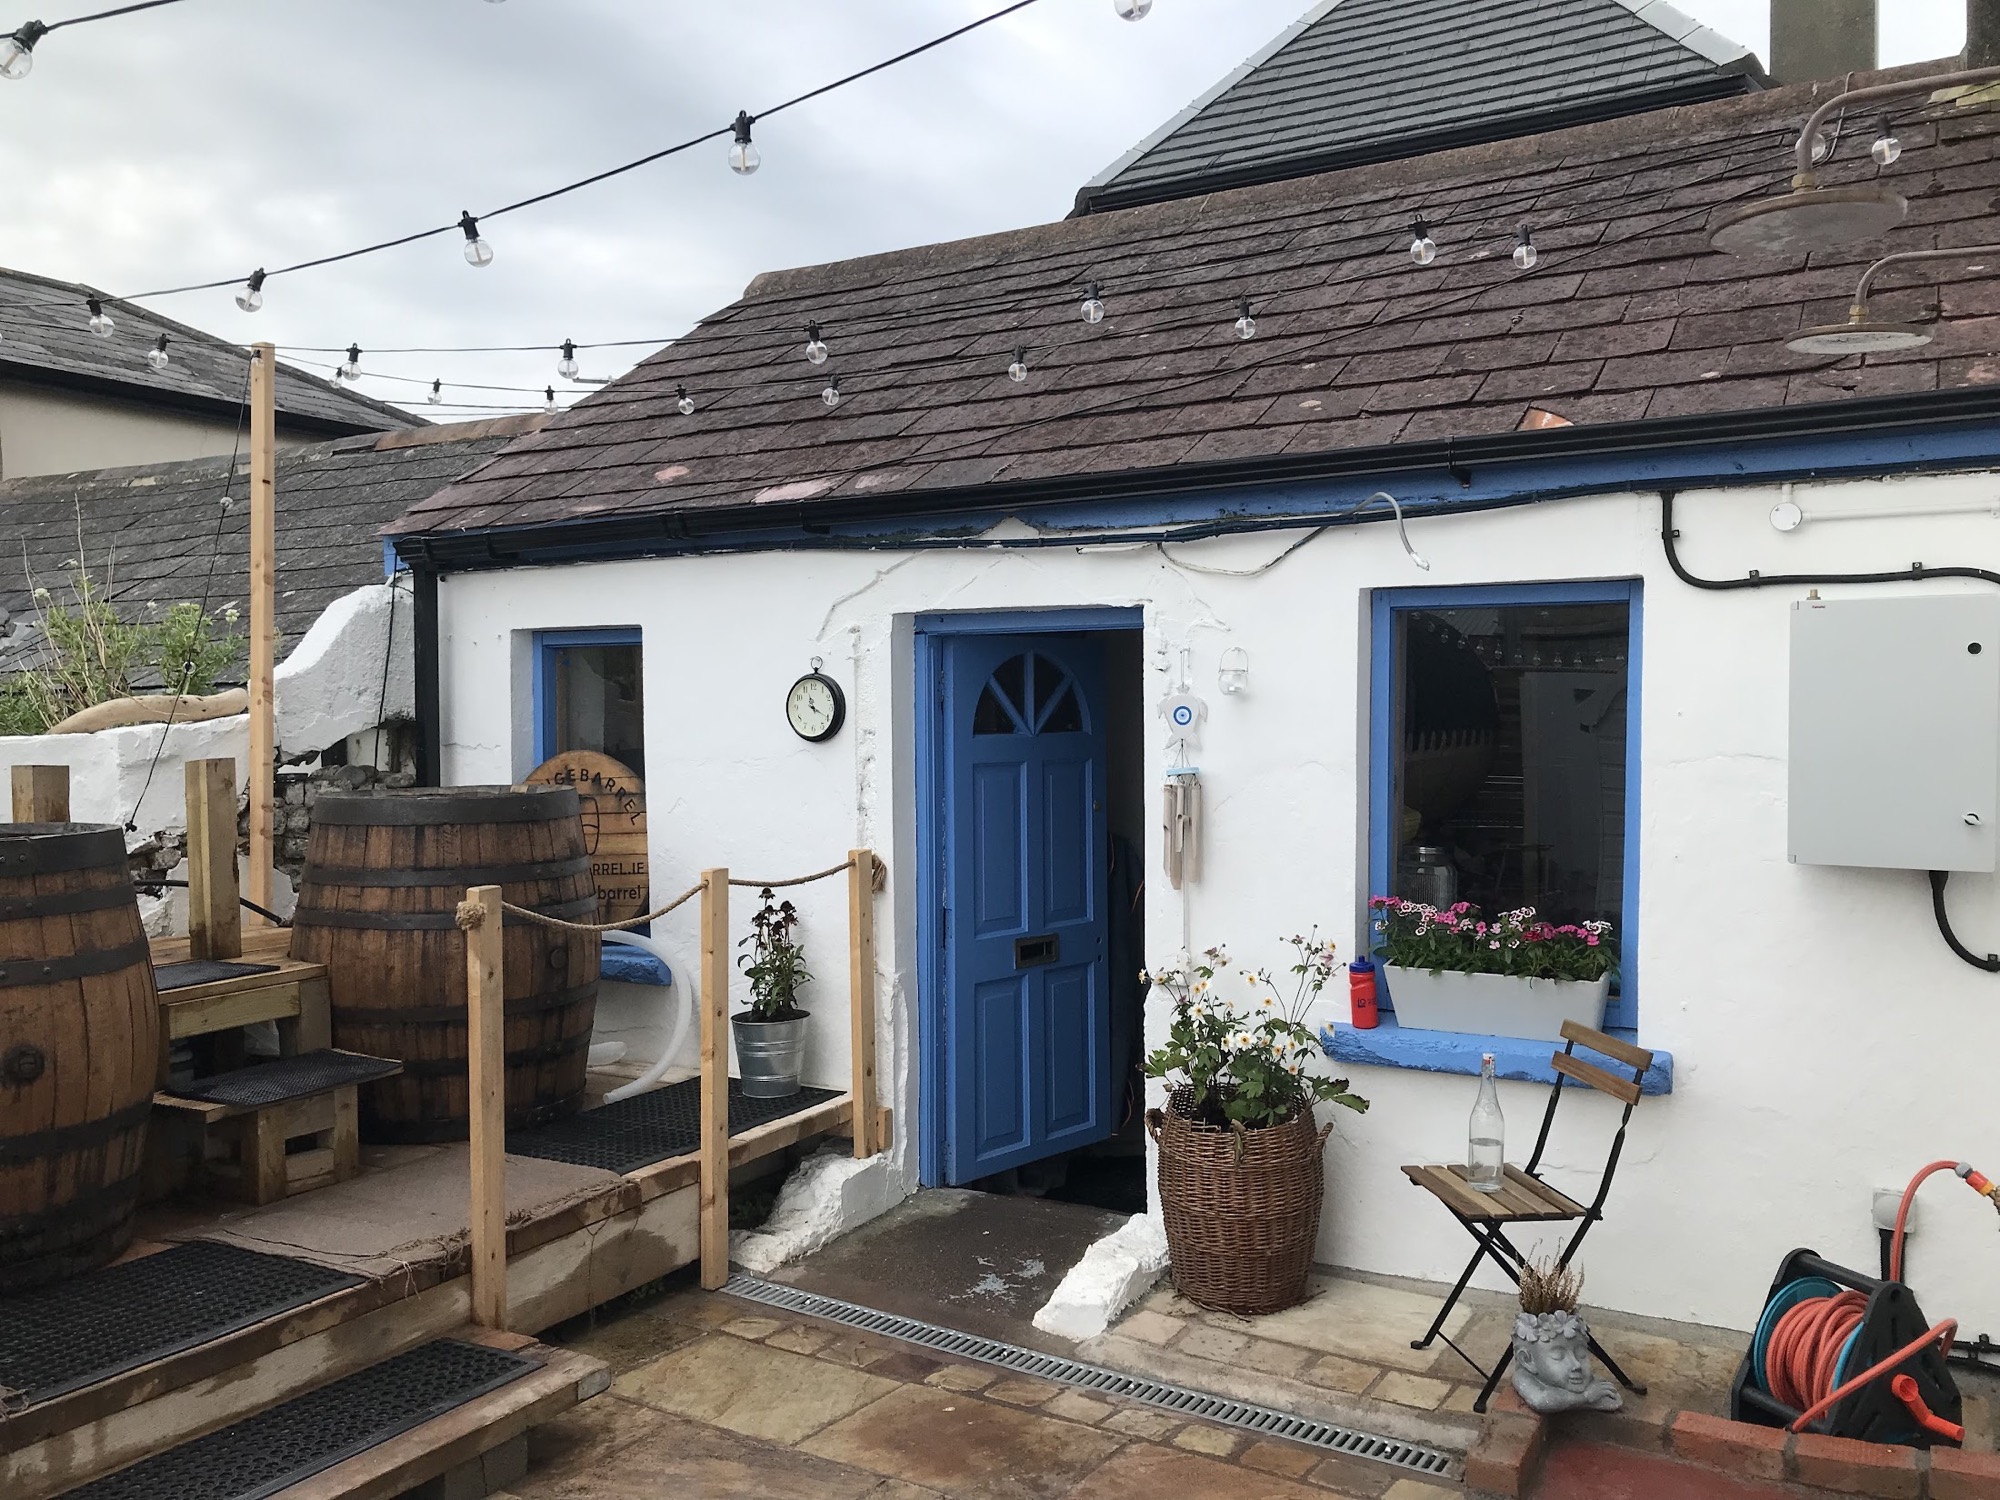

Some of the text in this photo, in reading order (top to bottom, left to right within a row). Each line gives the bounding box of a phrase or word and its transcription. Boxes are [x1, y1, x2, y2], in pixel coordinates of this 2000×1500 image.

[541, 768, 642, 826] GEBARREL
[592, 862, 645, 876] RREL.IE
[597, 884, 641, 900] barrel
